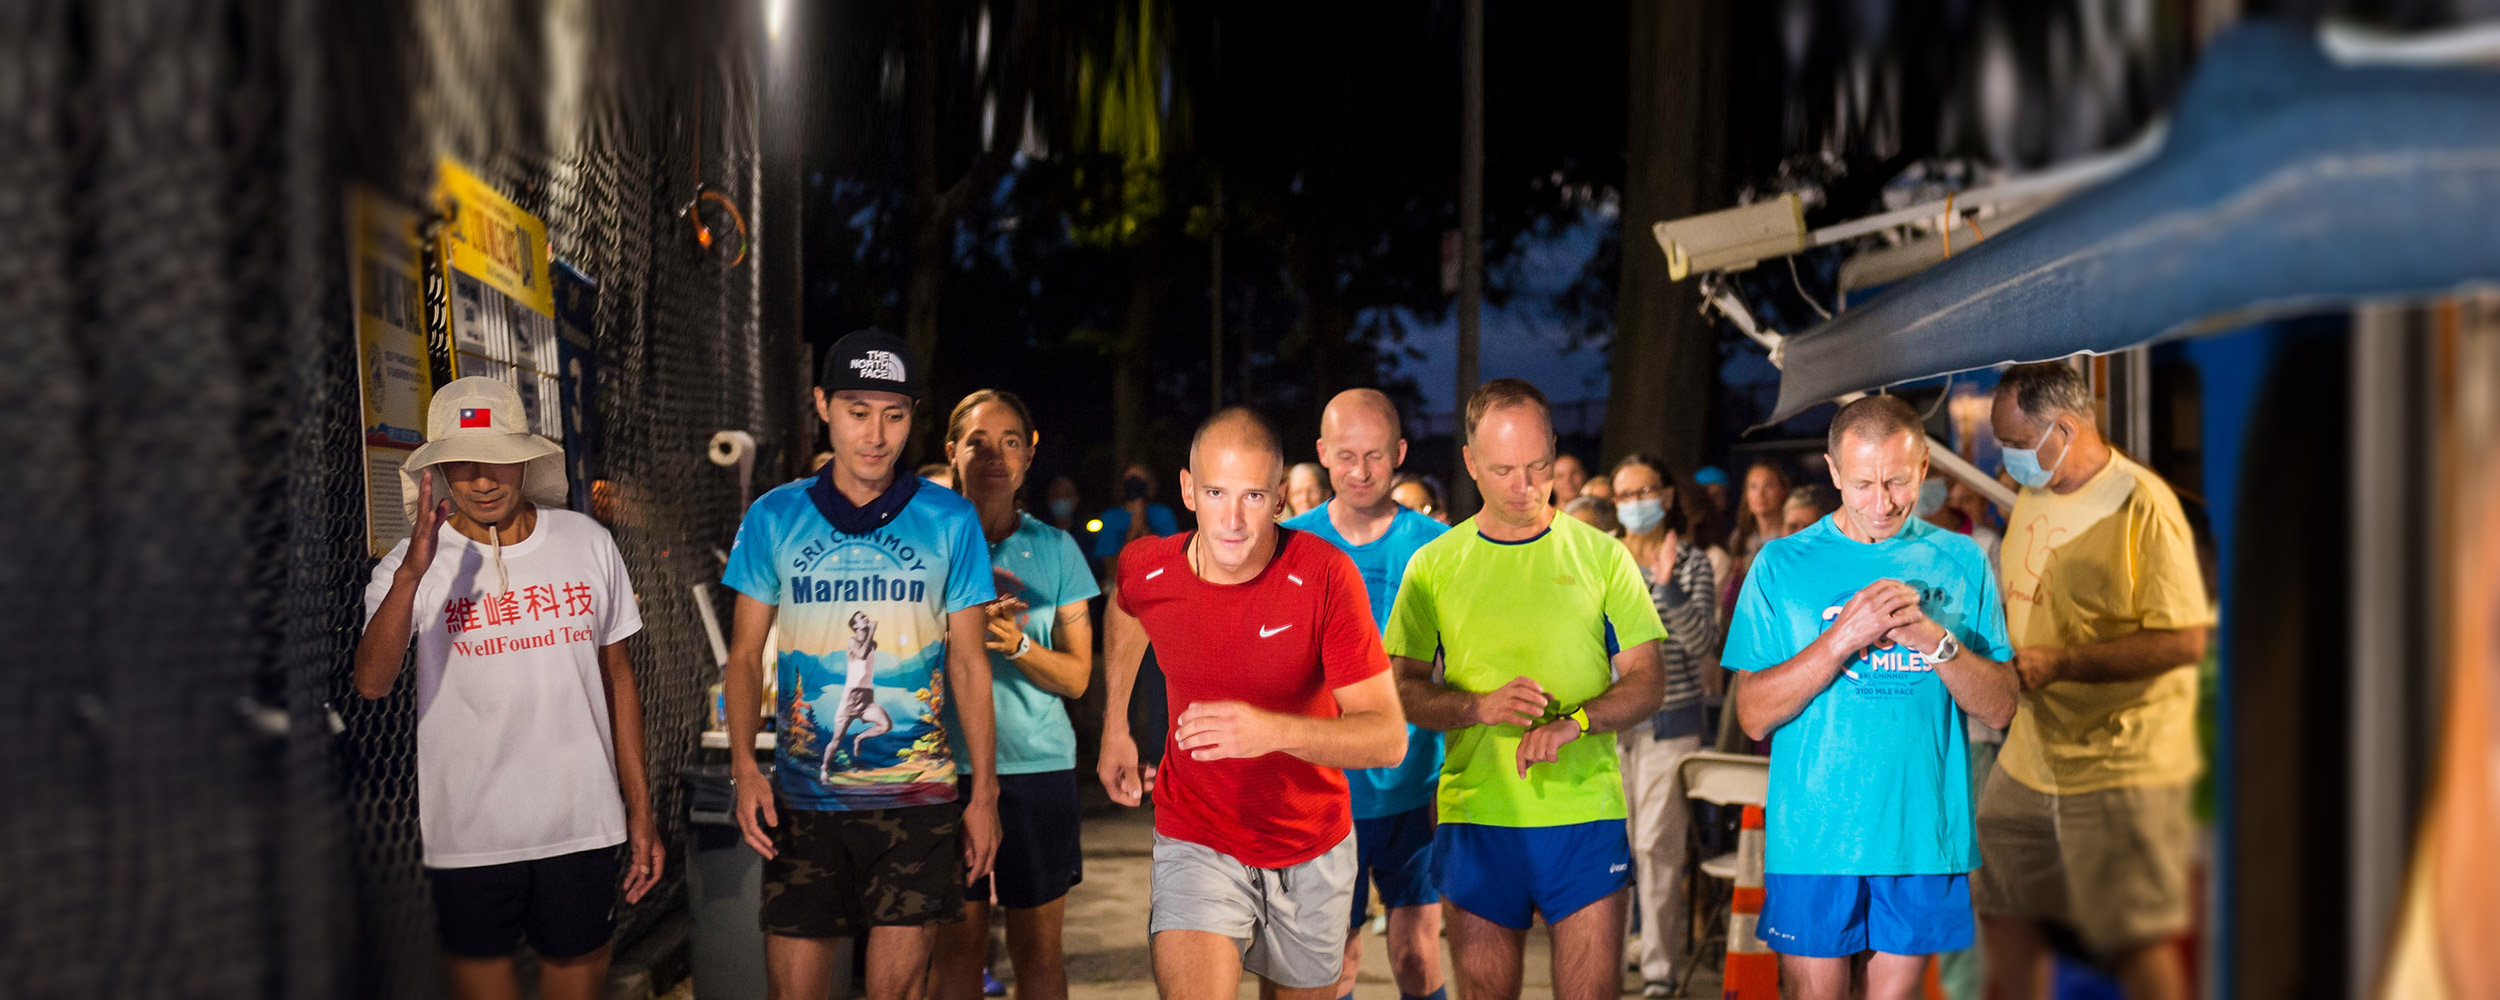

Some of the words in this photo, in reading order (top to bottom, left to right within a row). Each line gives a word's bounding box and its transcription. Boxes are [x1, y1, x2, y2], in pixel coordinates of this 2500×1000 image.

[850, 359, 890, 371] NORTH
[866, 350, 890, 361] THE
[860, 369, 890, 380] FACE
[793, 539, 825, 573] SRI
[791, 574, 925, 604] Marathon
[444, 581, 594, 635] 維峰科技
[453, 629, 556, 657] WellFound
[1871, 652, 1934, 672] MILES
[1856, 687, 1874, 695] 3100
[1875, 687, 1893, 696] MILE
[1894, 687, 1915, 696] RACE
